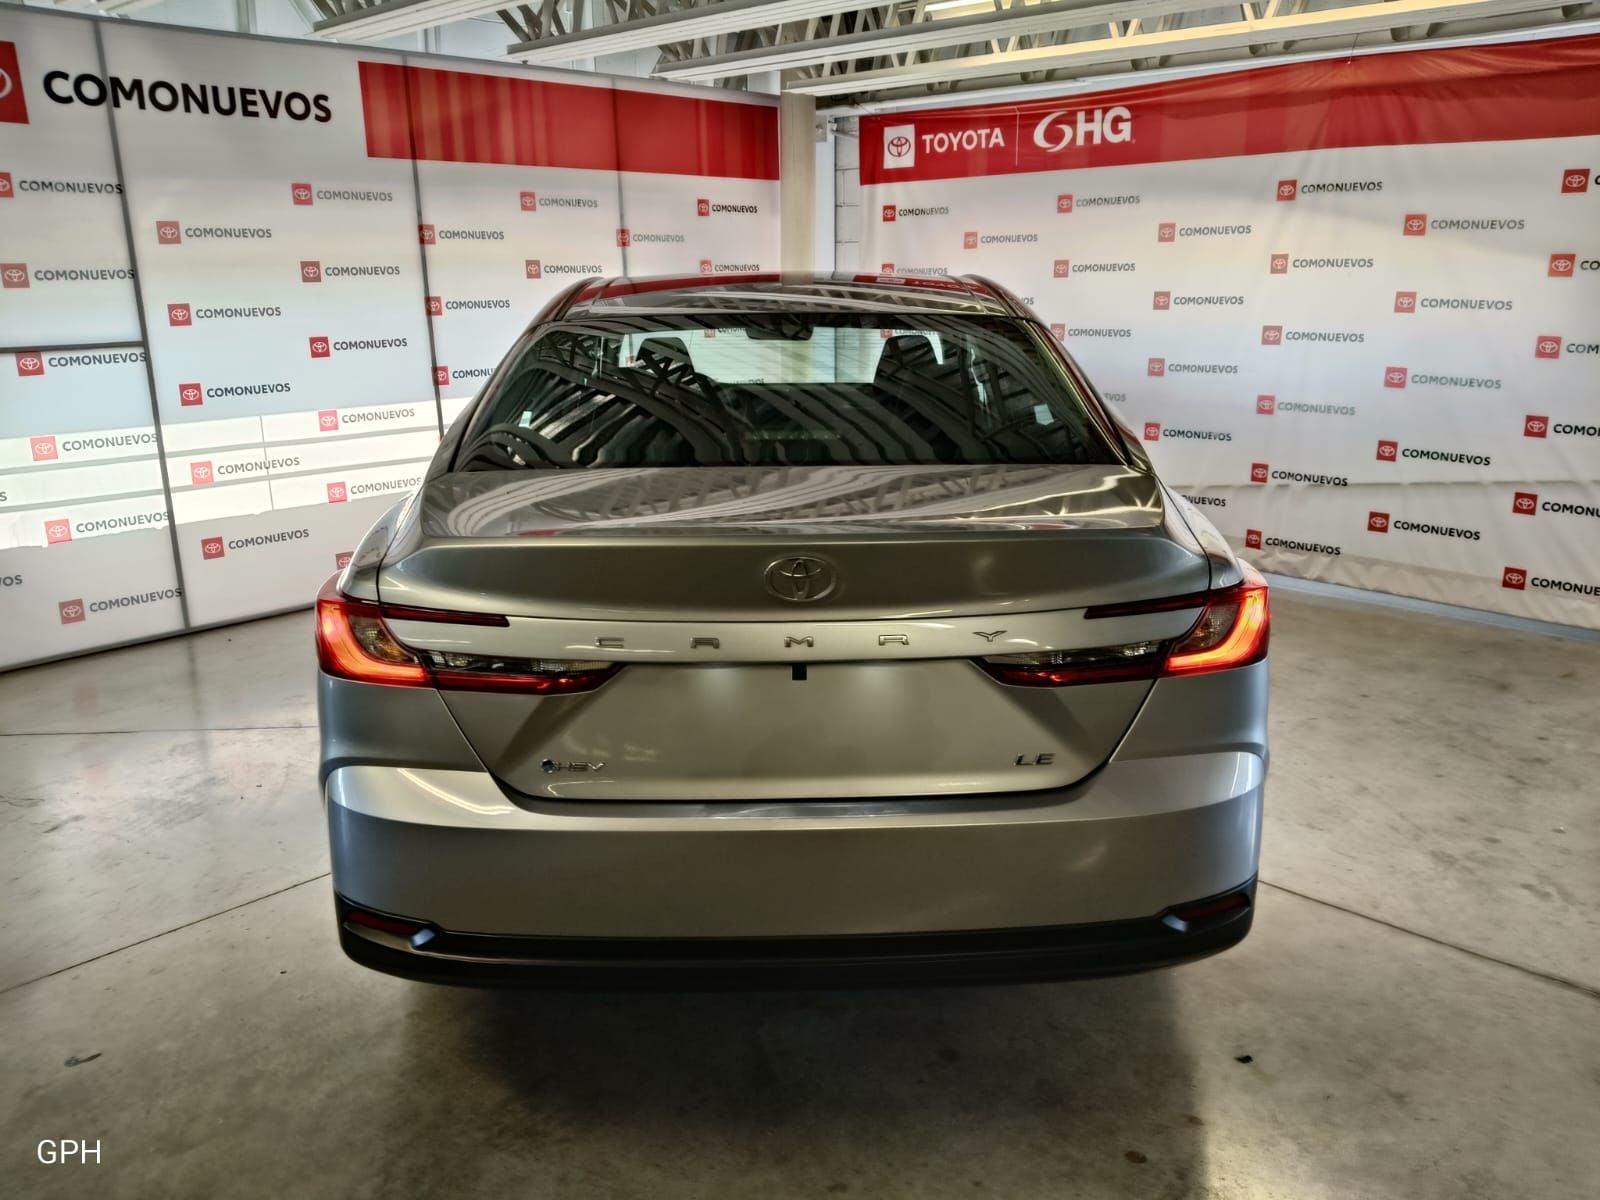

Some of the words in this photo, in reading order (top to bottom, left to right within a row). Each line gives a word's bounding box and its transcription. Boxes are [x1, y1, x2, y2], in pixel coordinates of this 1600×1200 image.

[43, 71, 332, 122] COMONUEVOS
[922, 128, 1004, 153] TOYOTA
[19, 180, 122, 194] COMONUEVOS
[1301, 182, 1382, 194] COMONUEVOS
[316, 190, 392, 201] COMONUEVOS
[1076, 195, 1140, 207] COMONUEVOS
[539, 197, 598, 208] COMONUEVOS
[712, 204, 757, 213] COMONUEVOS
[898, 207, 949, 216] COMONUEVOS
[1179, 225, 1251, 236] COMONUEVOS
[1431, 220, 1524, 230] COMONUEVOS
[185, 228, 272, 238] COMONUEVOS
[439, 230, 504, 240] COMONUEVOS
[633, 234, 684, 242] COMONUEVOS
[981, 234, 1038, 244] COMONUEVOS
[544, 265, 603, 273] COMONUEVOS
[715, 264, 760, 272] COMONUEVOS
[1072, 263, 1135, 272] COMONUEVOS
[1292, 259, 1373, 268] COMONUEVOS
[34, 269, 135, 281] COMONUEVOS
[325, 266, 400, 276] COMONUEVOS
[446, 300, 510, 310] COMONUEVOS
[1174, 296, 1244, 305] COMONUEVOS
[1420, 298, 1512, 310] COMONUEVOS
[196, 307, 281, 318] COMONUEVOS
[1068, 329, 1131, 337] COMONUEVOS
[1285, 331, 1364, 342] COMONUEVOS
[333, 338, 407, 351] COMONUEVOS
[48, 353, 146, 367] COMONUEVOS
[452, 368, 495, 379] COMONU
[1168, 364, 1238, 374] COMONUEVOS
[1411, 375, 1501, 389] COMONUEVOS
[206, 383, 290, 397] COMONUEVOS
[1278, 403, 1355, 415] COMONUEVOS
[342, 409, 415, 423] COMONUEVOS
[1163, 429, 1232, 441] COMONUEVOS
[62, 433, 158, 452] COMONUEVOS
[1402, 449, 1490, 465] COMONUEVOS
[217, 457, 300, 475] COMONUEVOS
[1271, 471, 1348, 486] COMONUEVOS
[350, 477, 421, 494] COMONUEVOS
[1181, 494, 1227, 507] NUEVOS
[1542, 501, 1600, 518] COMON
[76, 512, 169, 533] COMONUEVOS
[1394, 520, 1480, 540] COMONUEVOS
[229, 529, 309, 550] COMONUEVOS
[1265, 538, 1341, 555] COMONUEVOS
[1531, 577, 1600, 596] COMONUE
[89, 588, 182, 613] COMONUEVOS
[1013, 752, 1056, 766] LE
